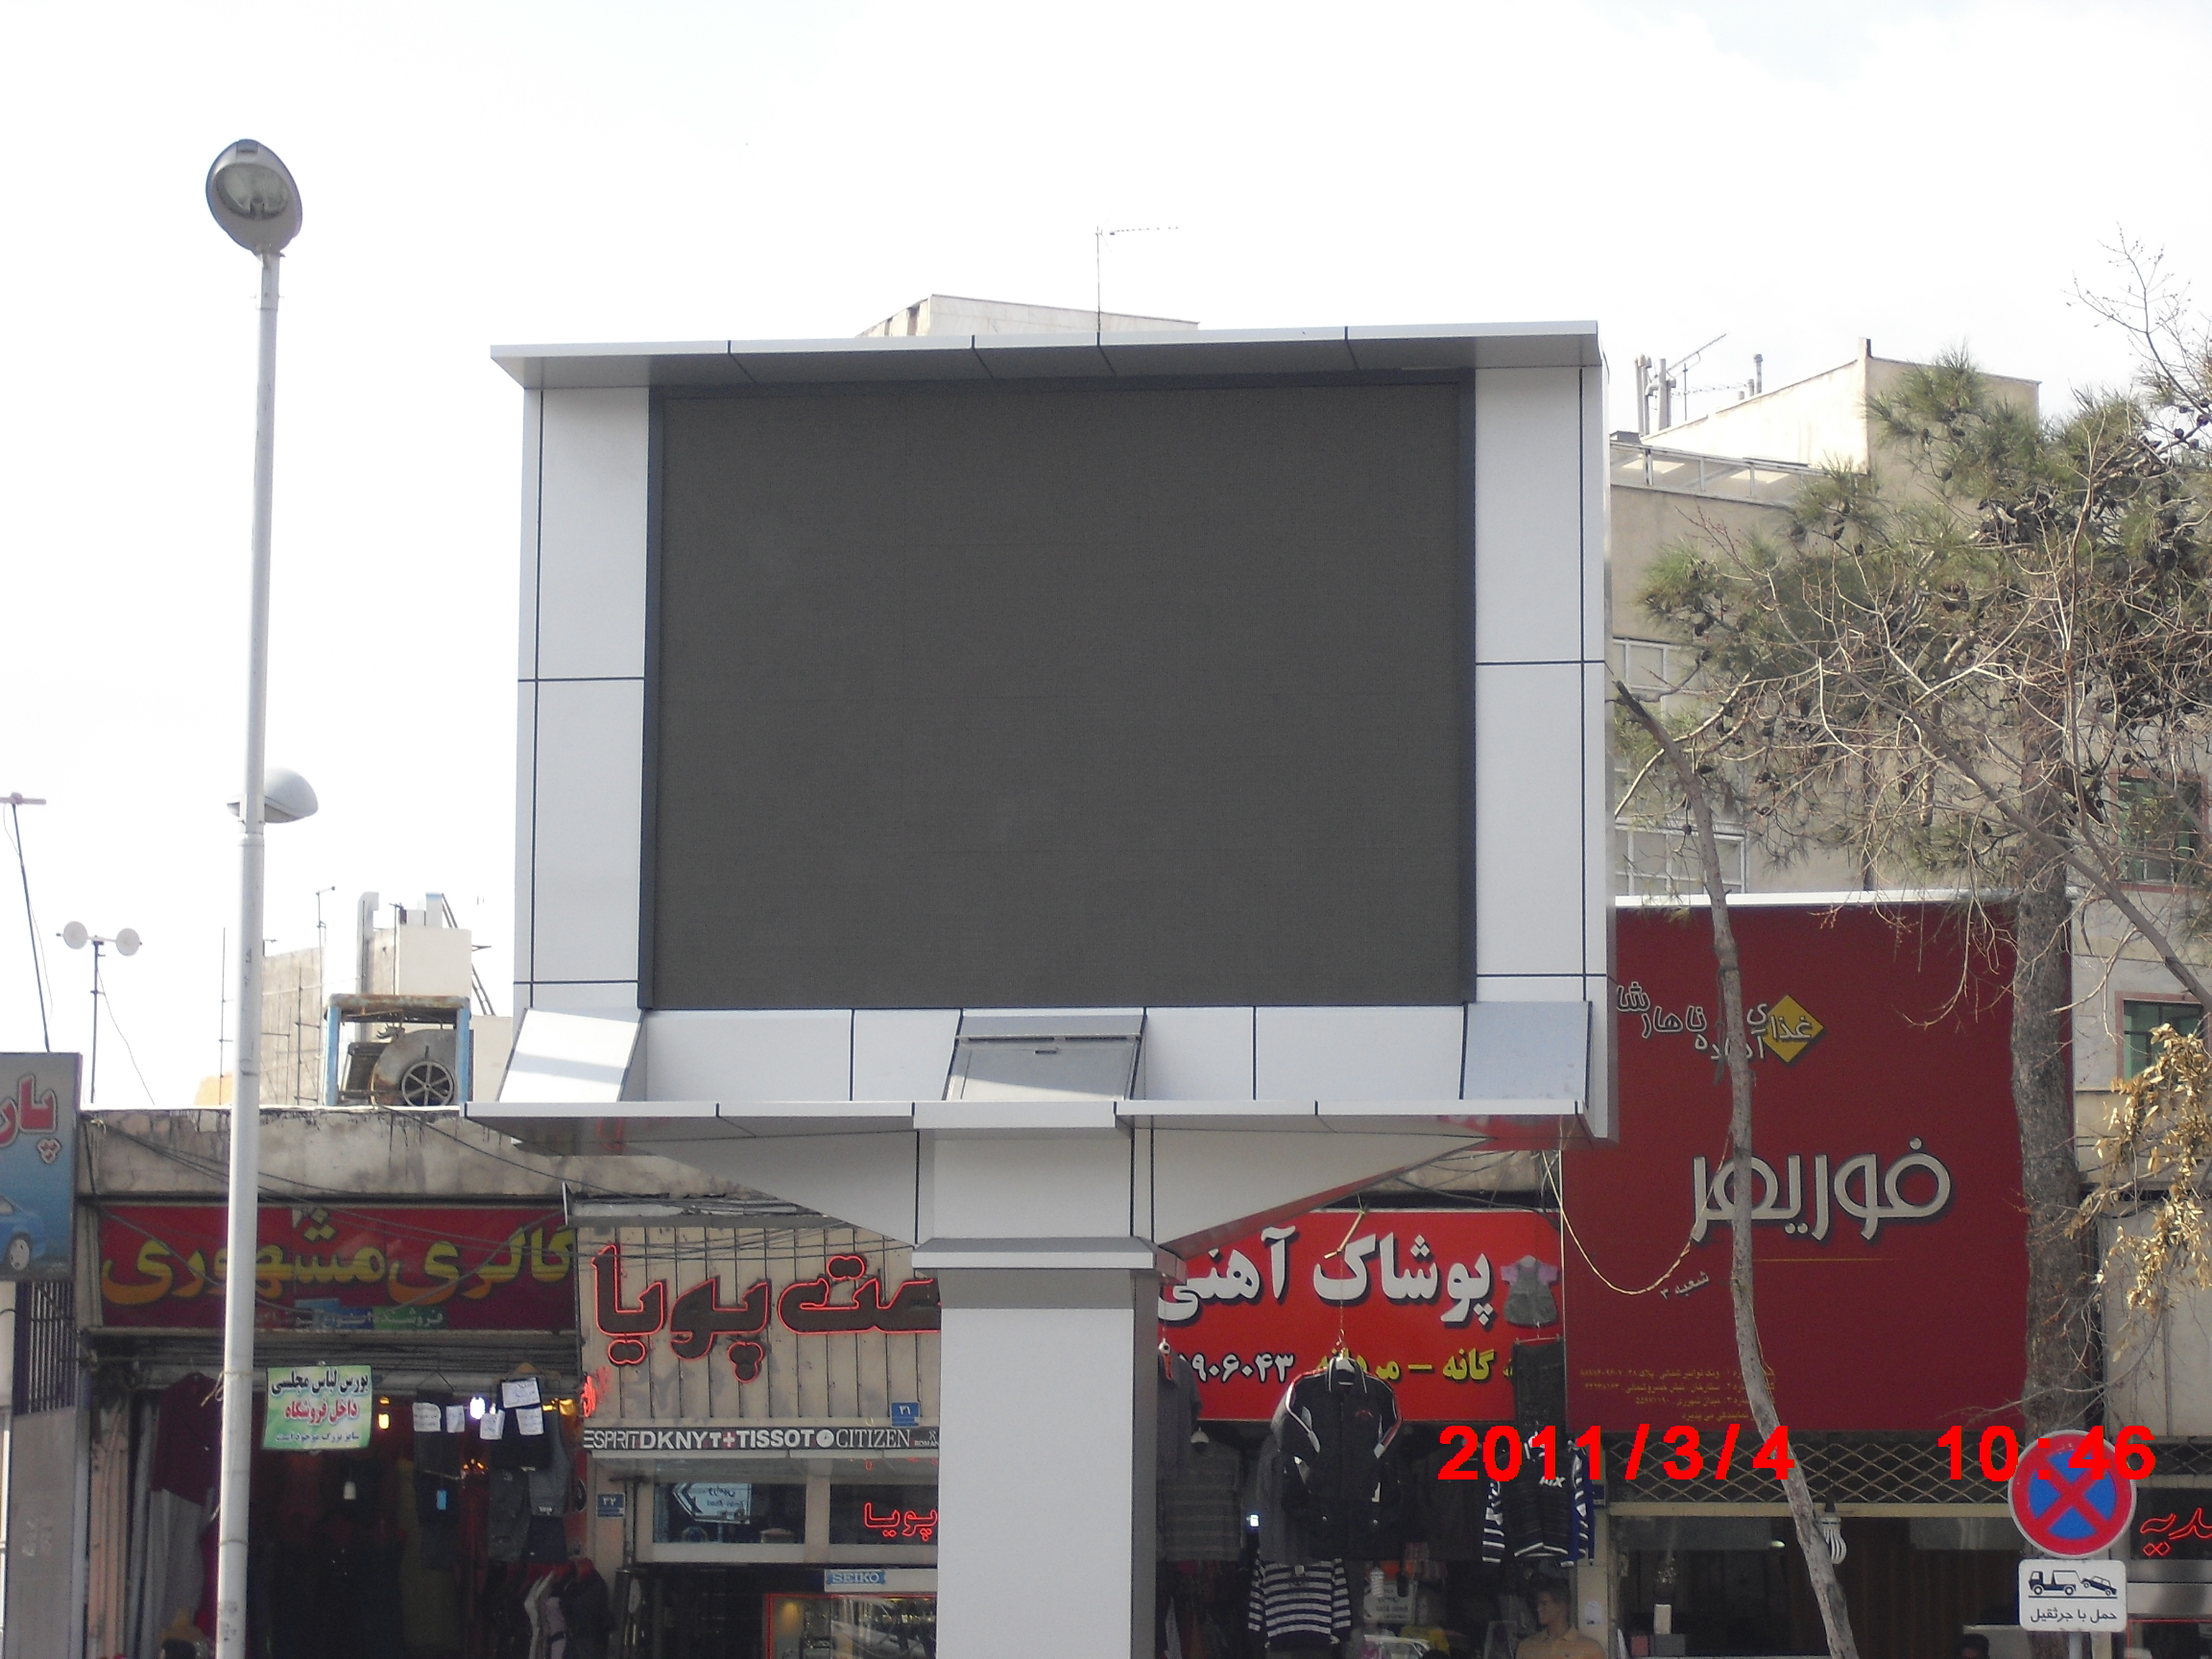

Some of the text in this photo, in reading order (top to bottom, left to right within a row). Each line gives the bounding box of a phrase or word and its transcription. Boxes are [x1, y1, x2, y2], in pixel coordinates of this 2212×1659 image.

[388, 1222, 575, 1307] گالری
[1312, 1232, 1495, 1326] پوشاک
[591, 1243, 770, 1383] پویا
[272, 1369, 369, 1394] بورس لباس مجلسی
[285, 1399, 358, 1424] داخل فروشگاه
[584, 1430, 637, 1449] ESPRIT
[639, 1431, 706, 1449] DKNY
[735, 1429, 814, 1448] TISSOT
[835, 1428, 910, 1449] CITIZEN
[864, 1502, 938, 1542] پویا
[831, 1573, 880, 1584] SEIKO
[2030, 1607, 2117, 1623] حمل با جرثقیل
